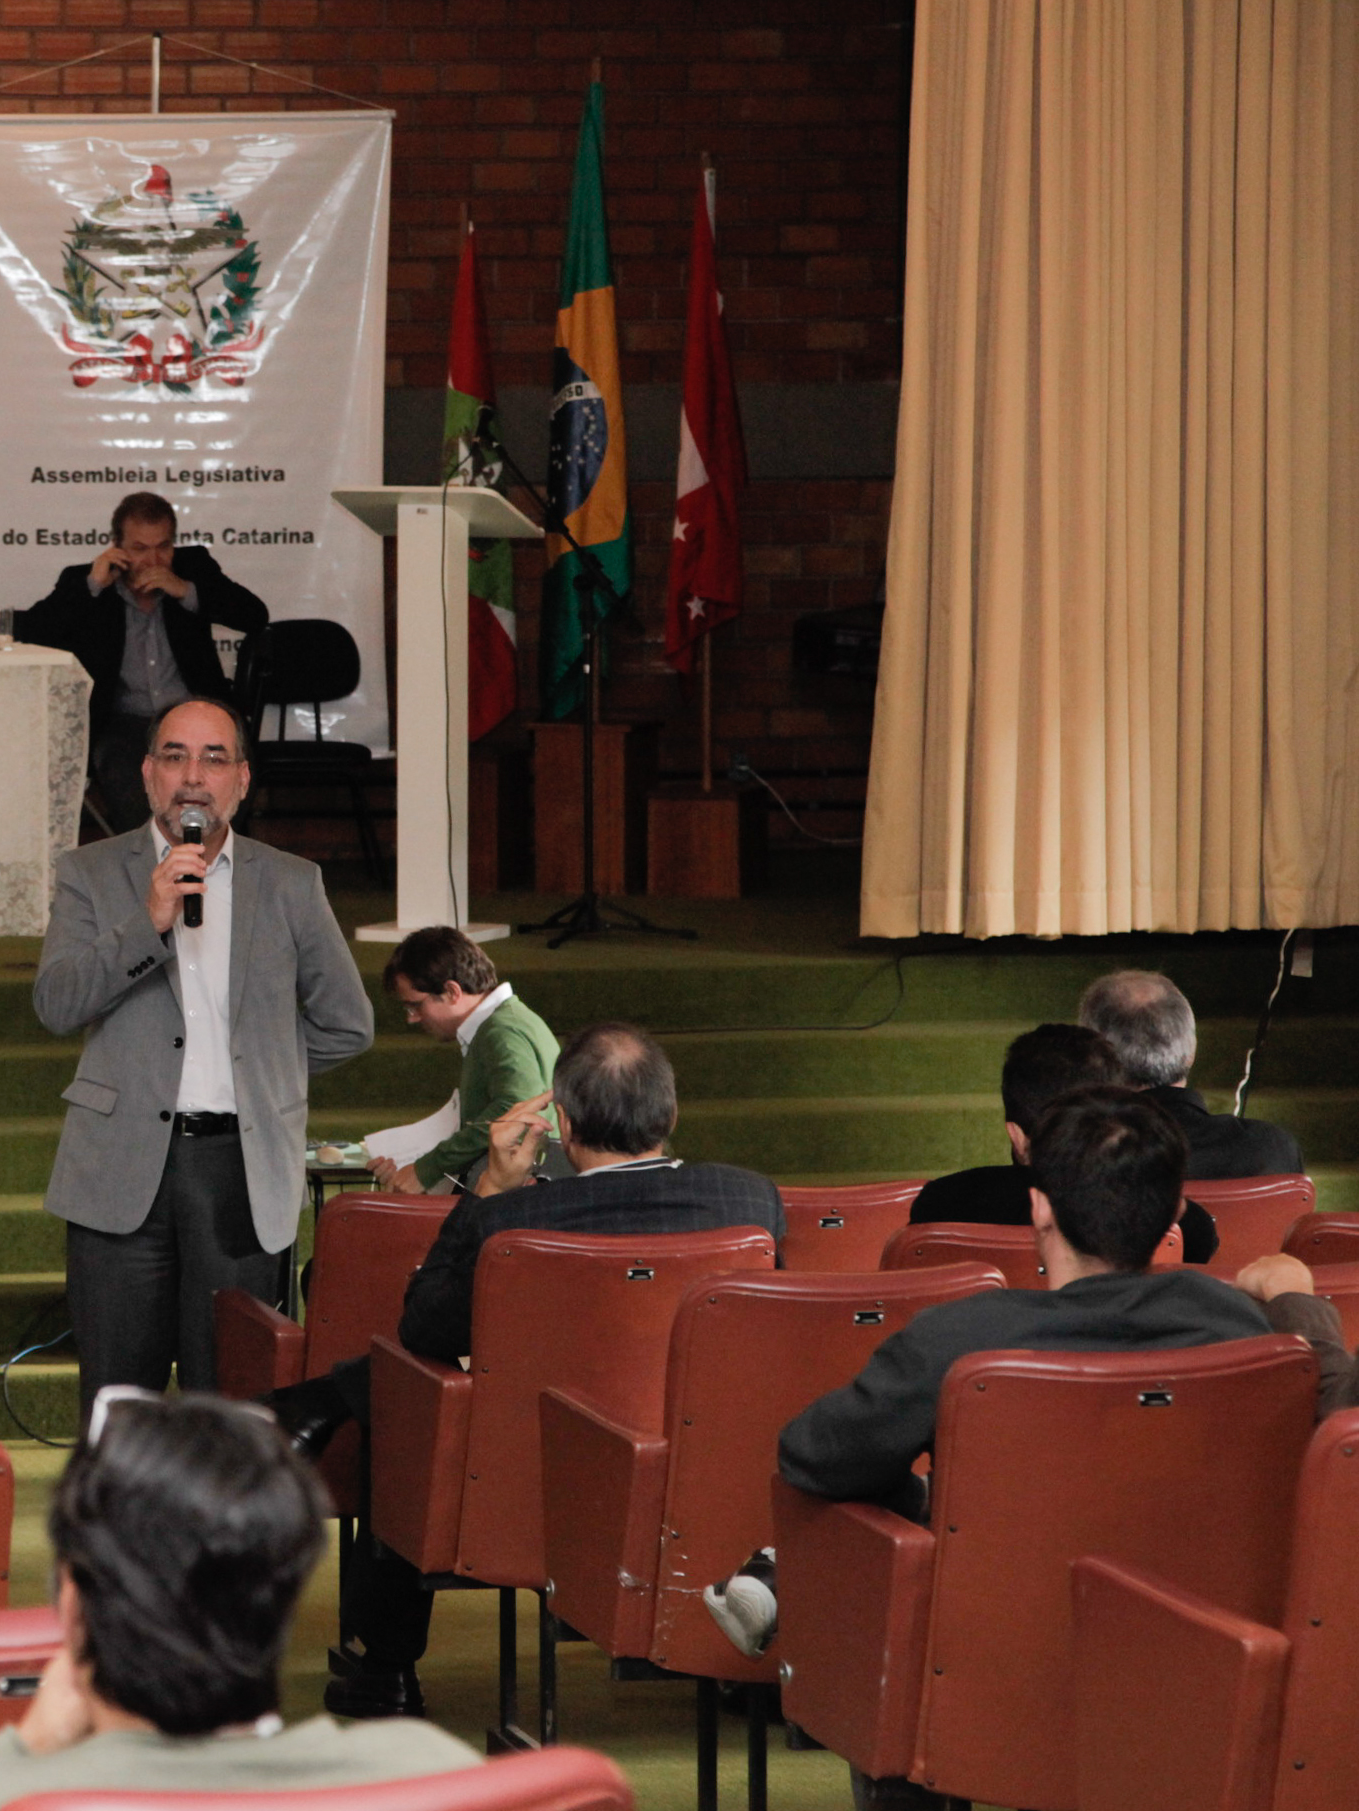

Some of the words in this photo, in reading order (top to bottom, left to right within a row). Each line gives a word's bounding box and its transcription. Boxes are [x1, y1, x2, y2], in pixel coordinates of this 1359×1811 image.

[31, 466, 157, 483] Assembleia
[165, 465, 285, 487] Legislativa
[2, 528, 28, 546] do
[36, 527, 111, 546] Estado
[222, 526, 315, 545] Catarina
